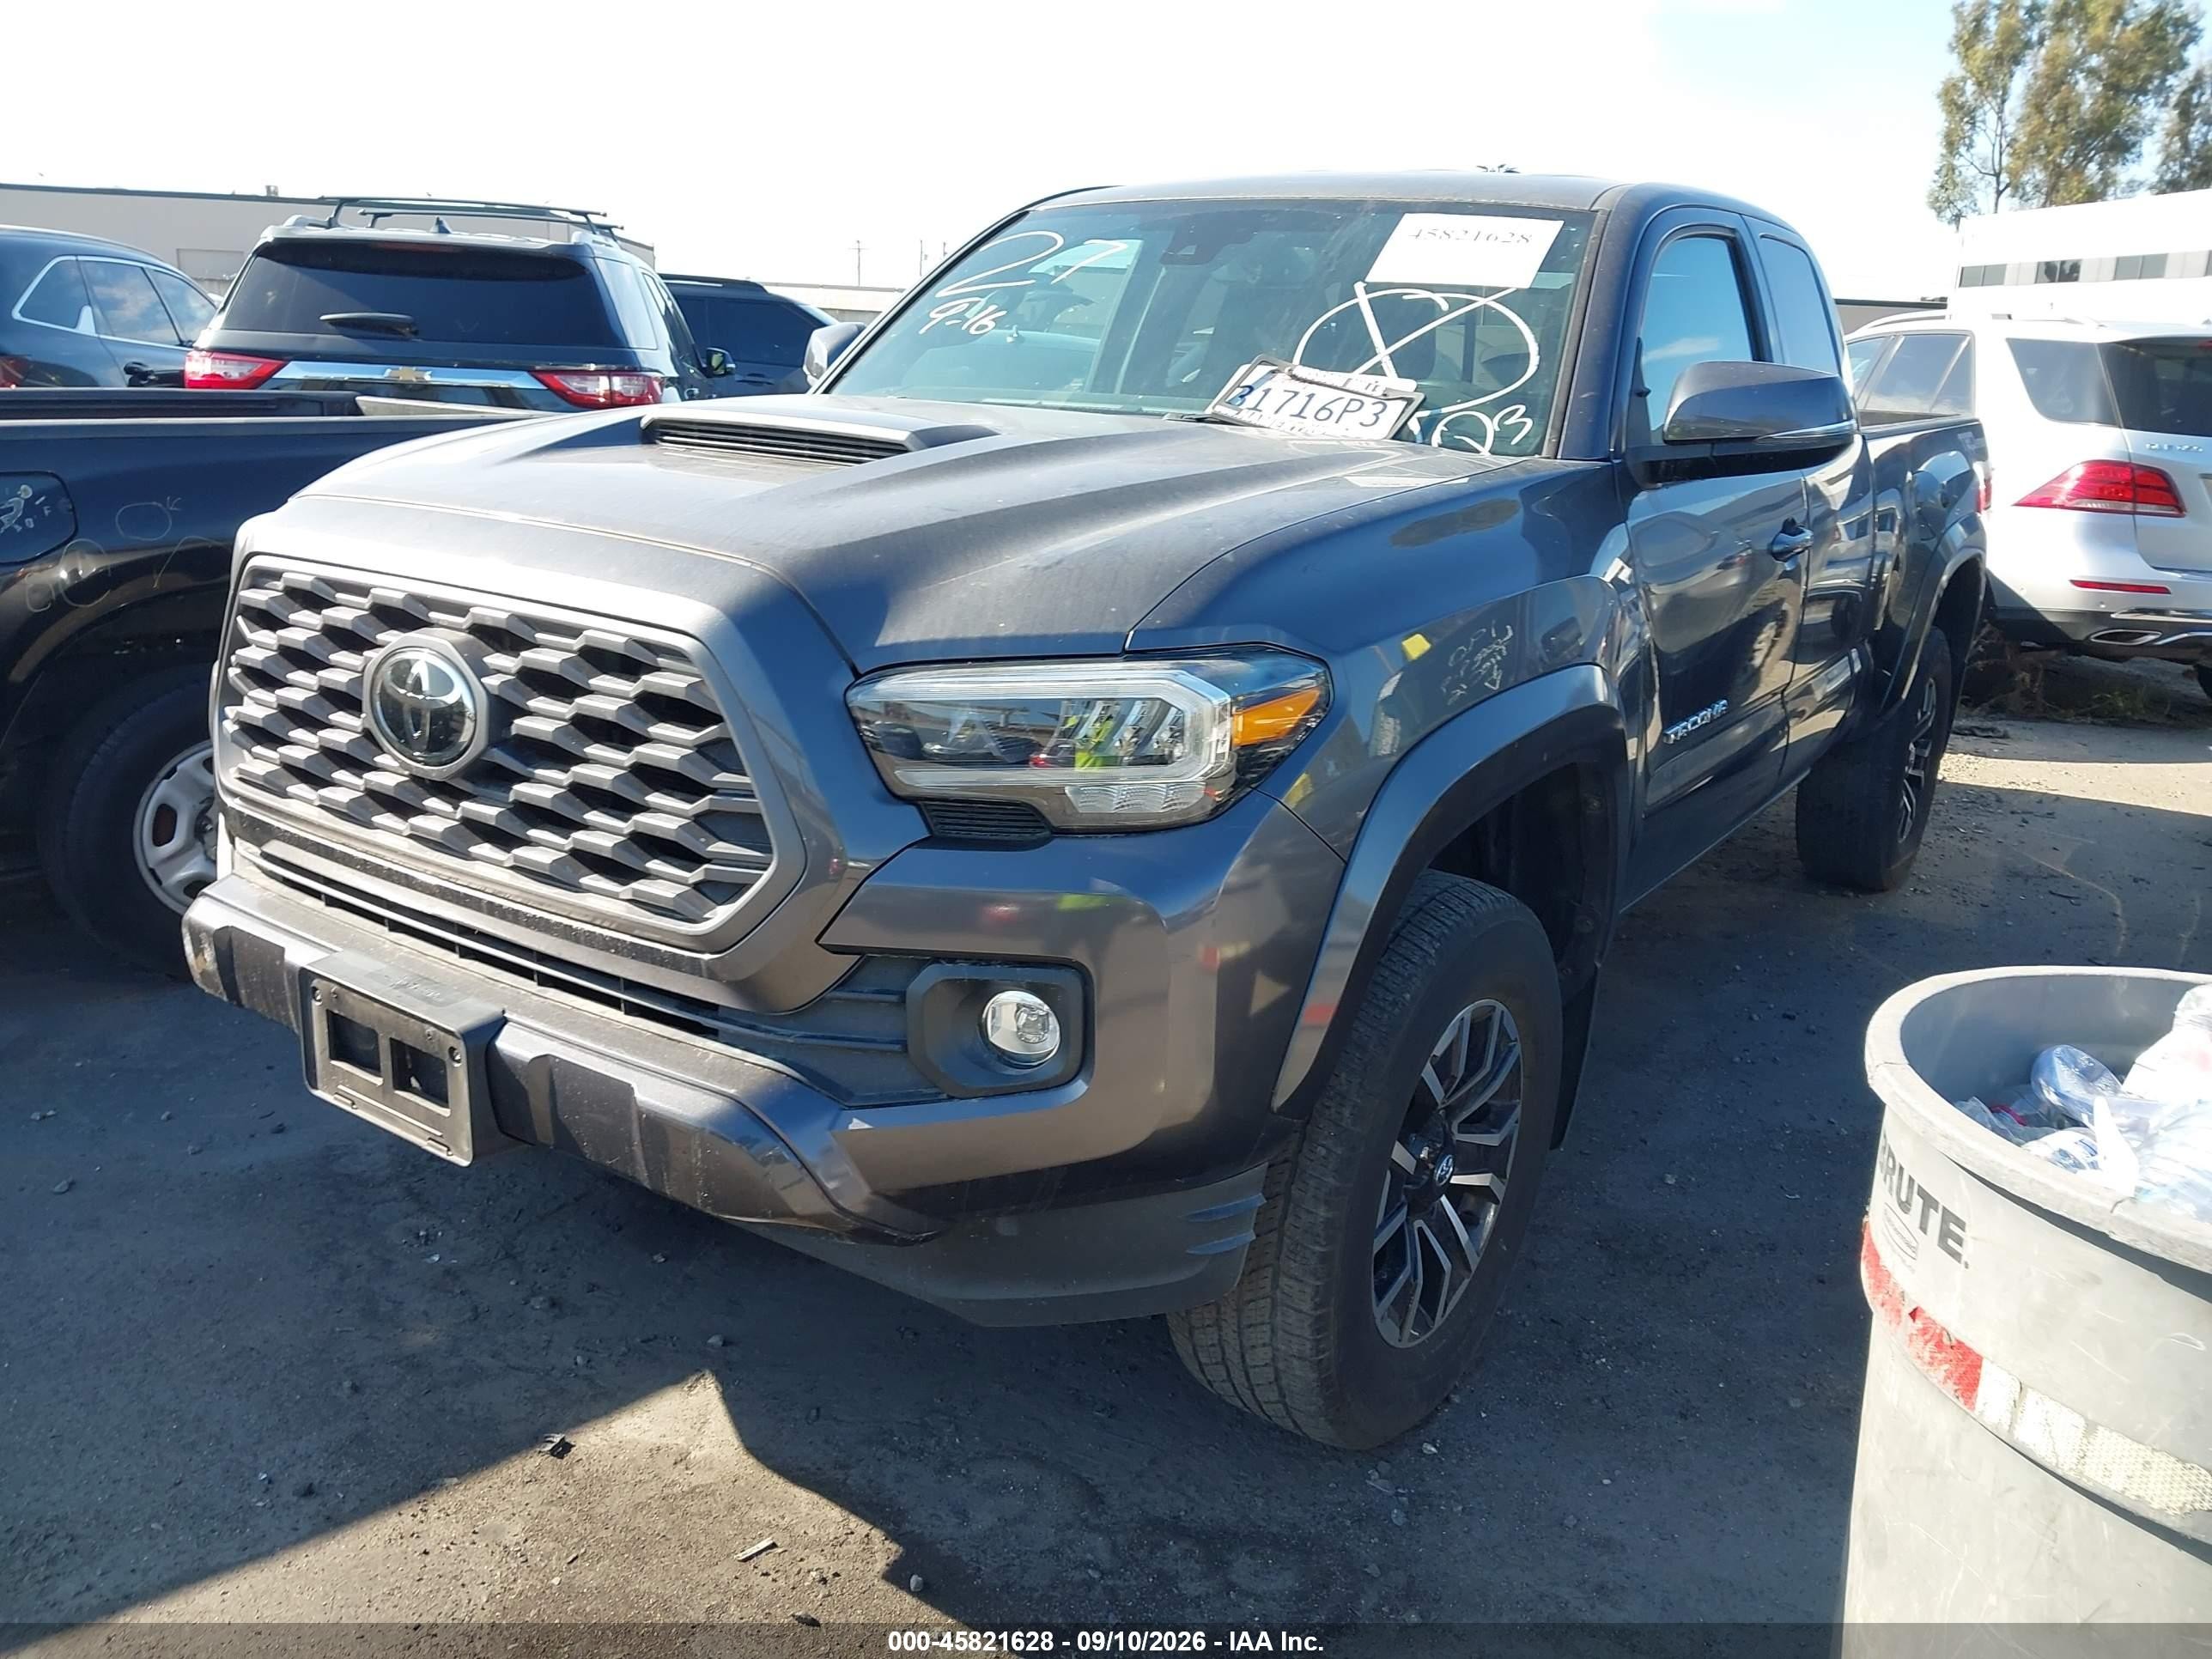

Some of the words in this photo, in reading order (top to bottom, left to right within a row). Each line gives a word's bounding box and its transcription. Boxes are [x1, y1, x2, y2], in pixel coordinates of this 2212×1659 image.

[1408, 228, 1533, 244] 45821628
[919, 297, 1007, 335] 9-16
[1662, 699, 1729, 744] TACOMA
